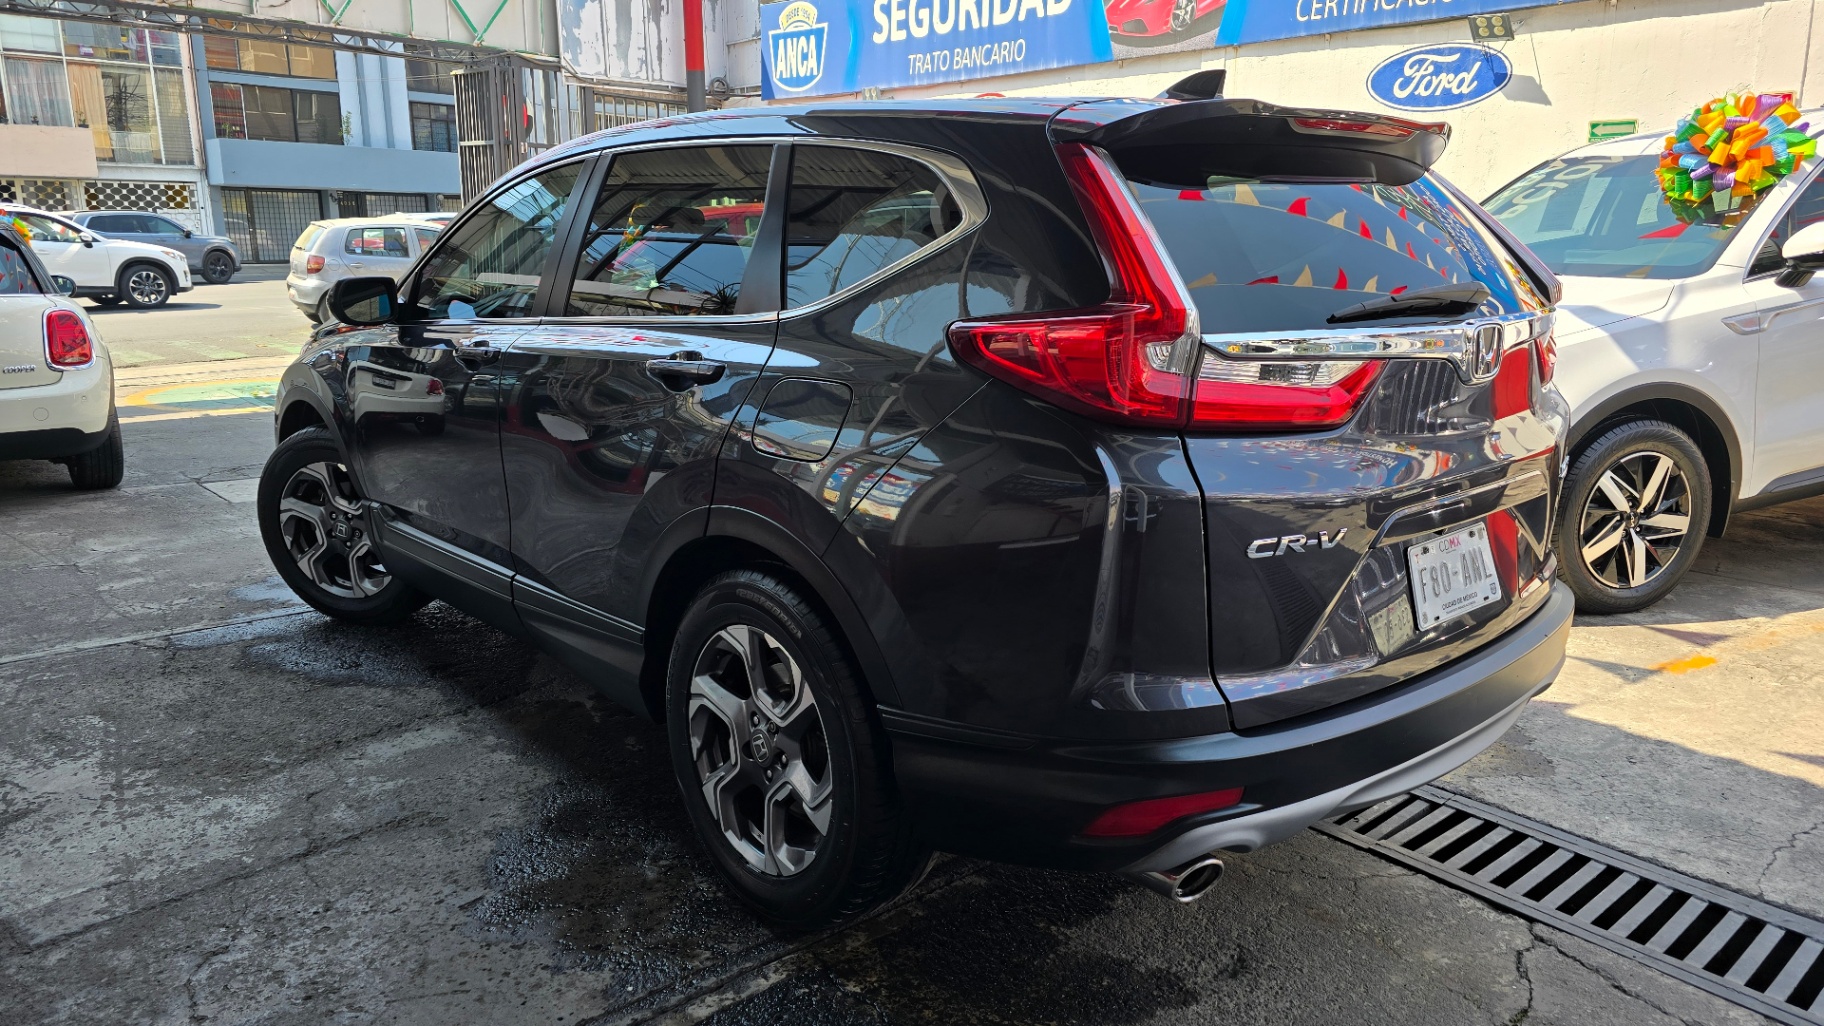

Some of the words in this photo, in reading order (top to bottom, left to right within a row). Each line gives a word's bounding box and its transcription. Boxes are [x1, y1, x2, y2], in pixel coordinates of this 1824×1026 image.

[776, 35, 818, 79] ANCA
[908, 50, 950, 75] TRATO
[953, 39, 1026, 71] BANCARIO
[1393, 53, 1482, 99] Ford
[3, 364, 36, 374] COOPER
[1246, 528, 1348, 559] CR-V
[1438, 535, 1461, 553] CDMX
[1419, 545, 1493, 604] F80-ANL
